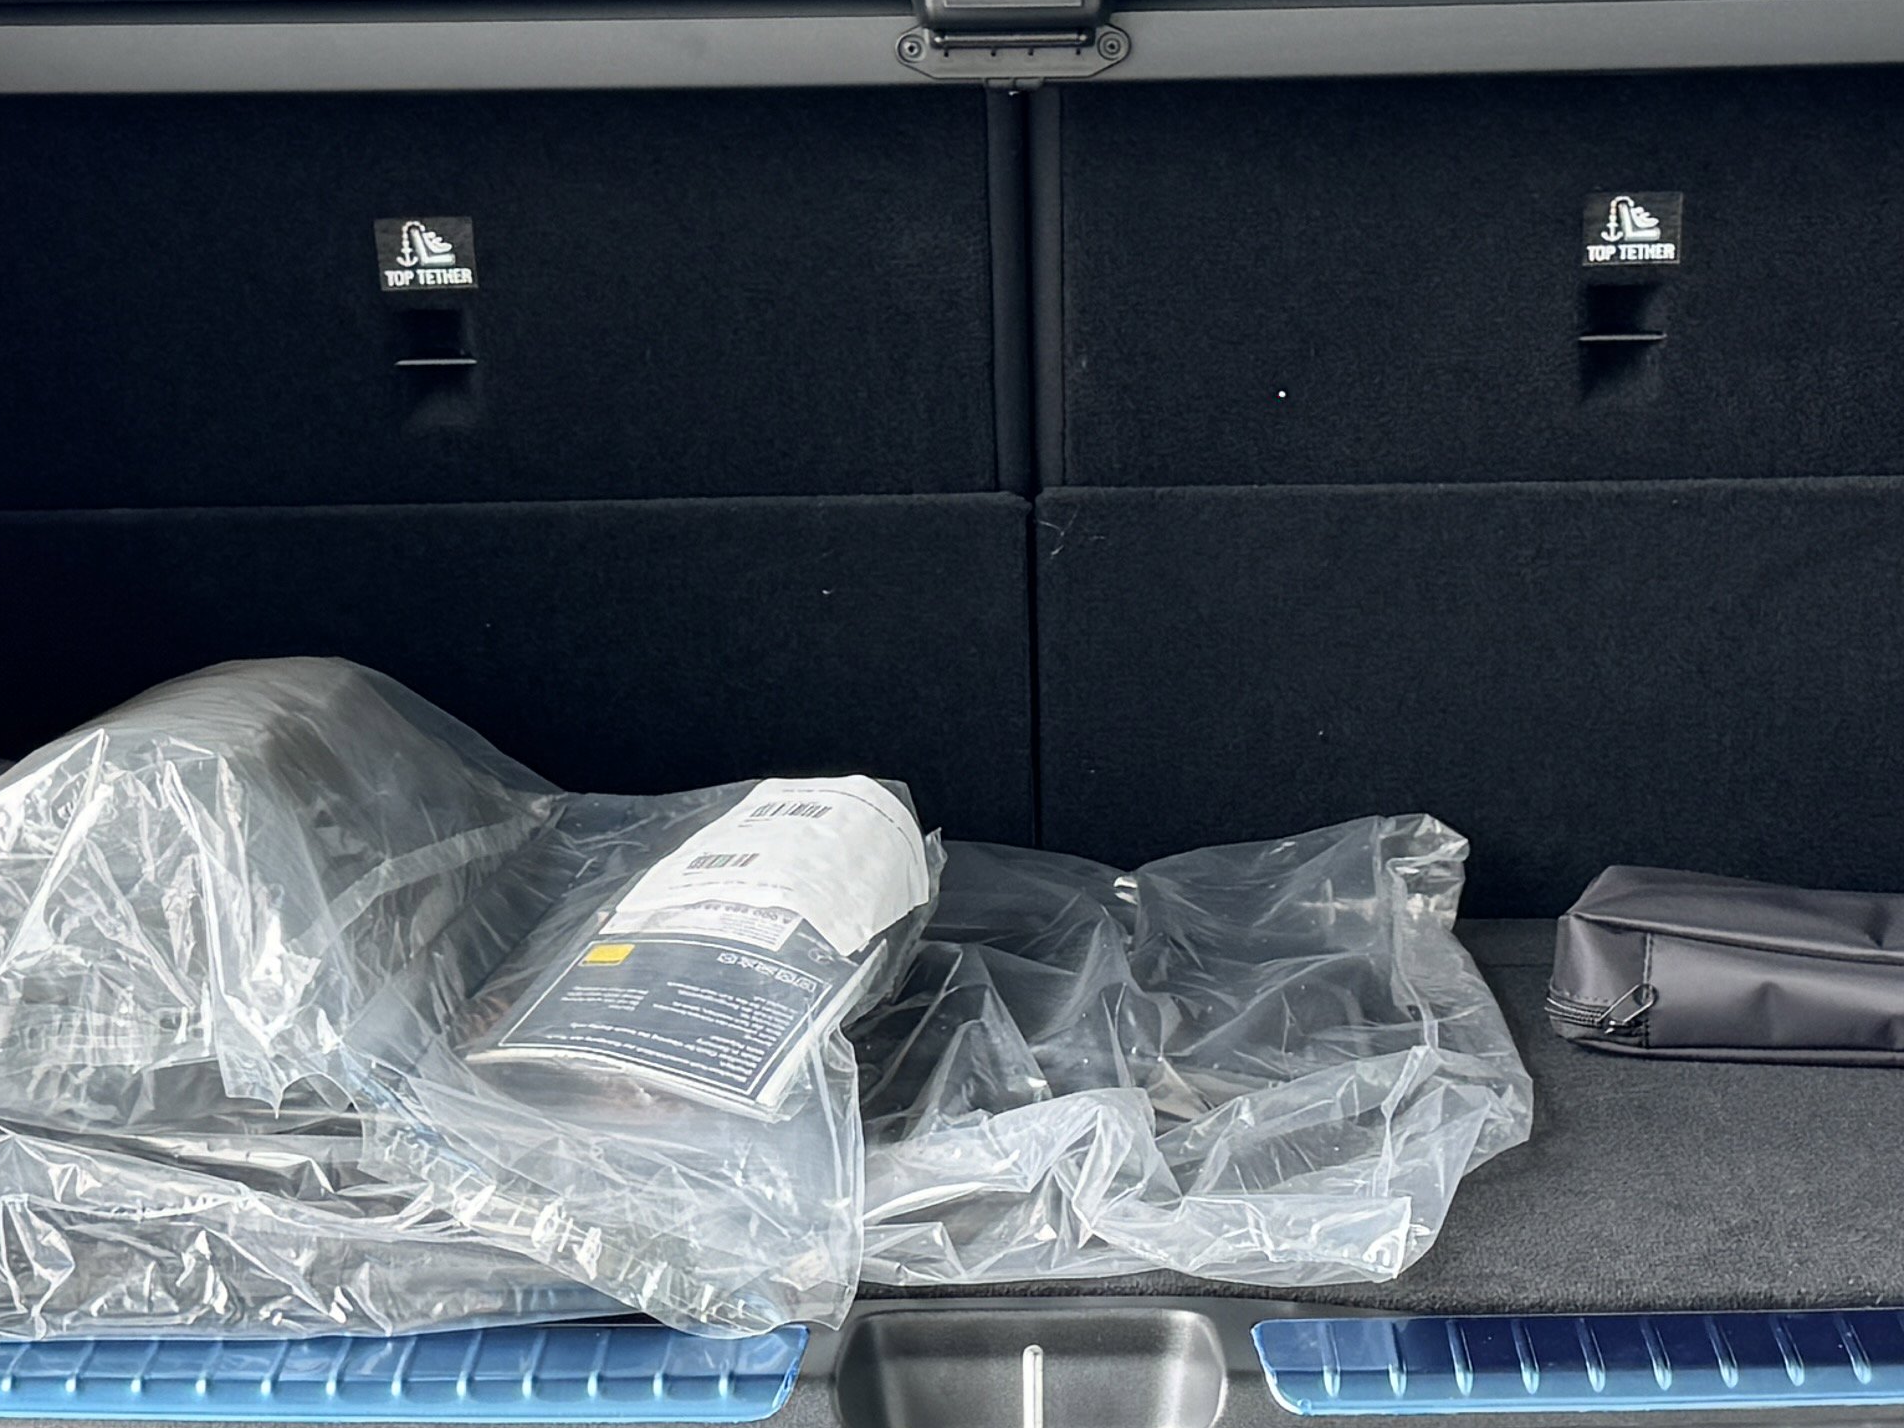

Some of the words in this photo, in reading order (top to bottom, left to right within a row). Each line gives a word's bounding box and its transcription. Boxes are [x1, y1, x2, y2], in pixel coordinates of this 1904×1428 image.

[1587, 245, 1616, 262] TOP
[1618, 243, 1676, 260] TETHER
[384, 270, 414, 287] TOP
[416, 268, 473, 285] TETHER
